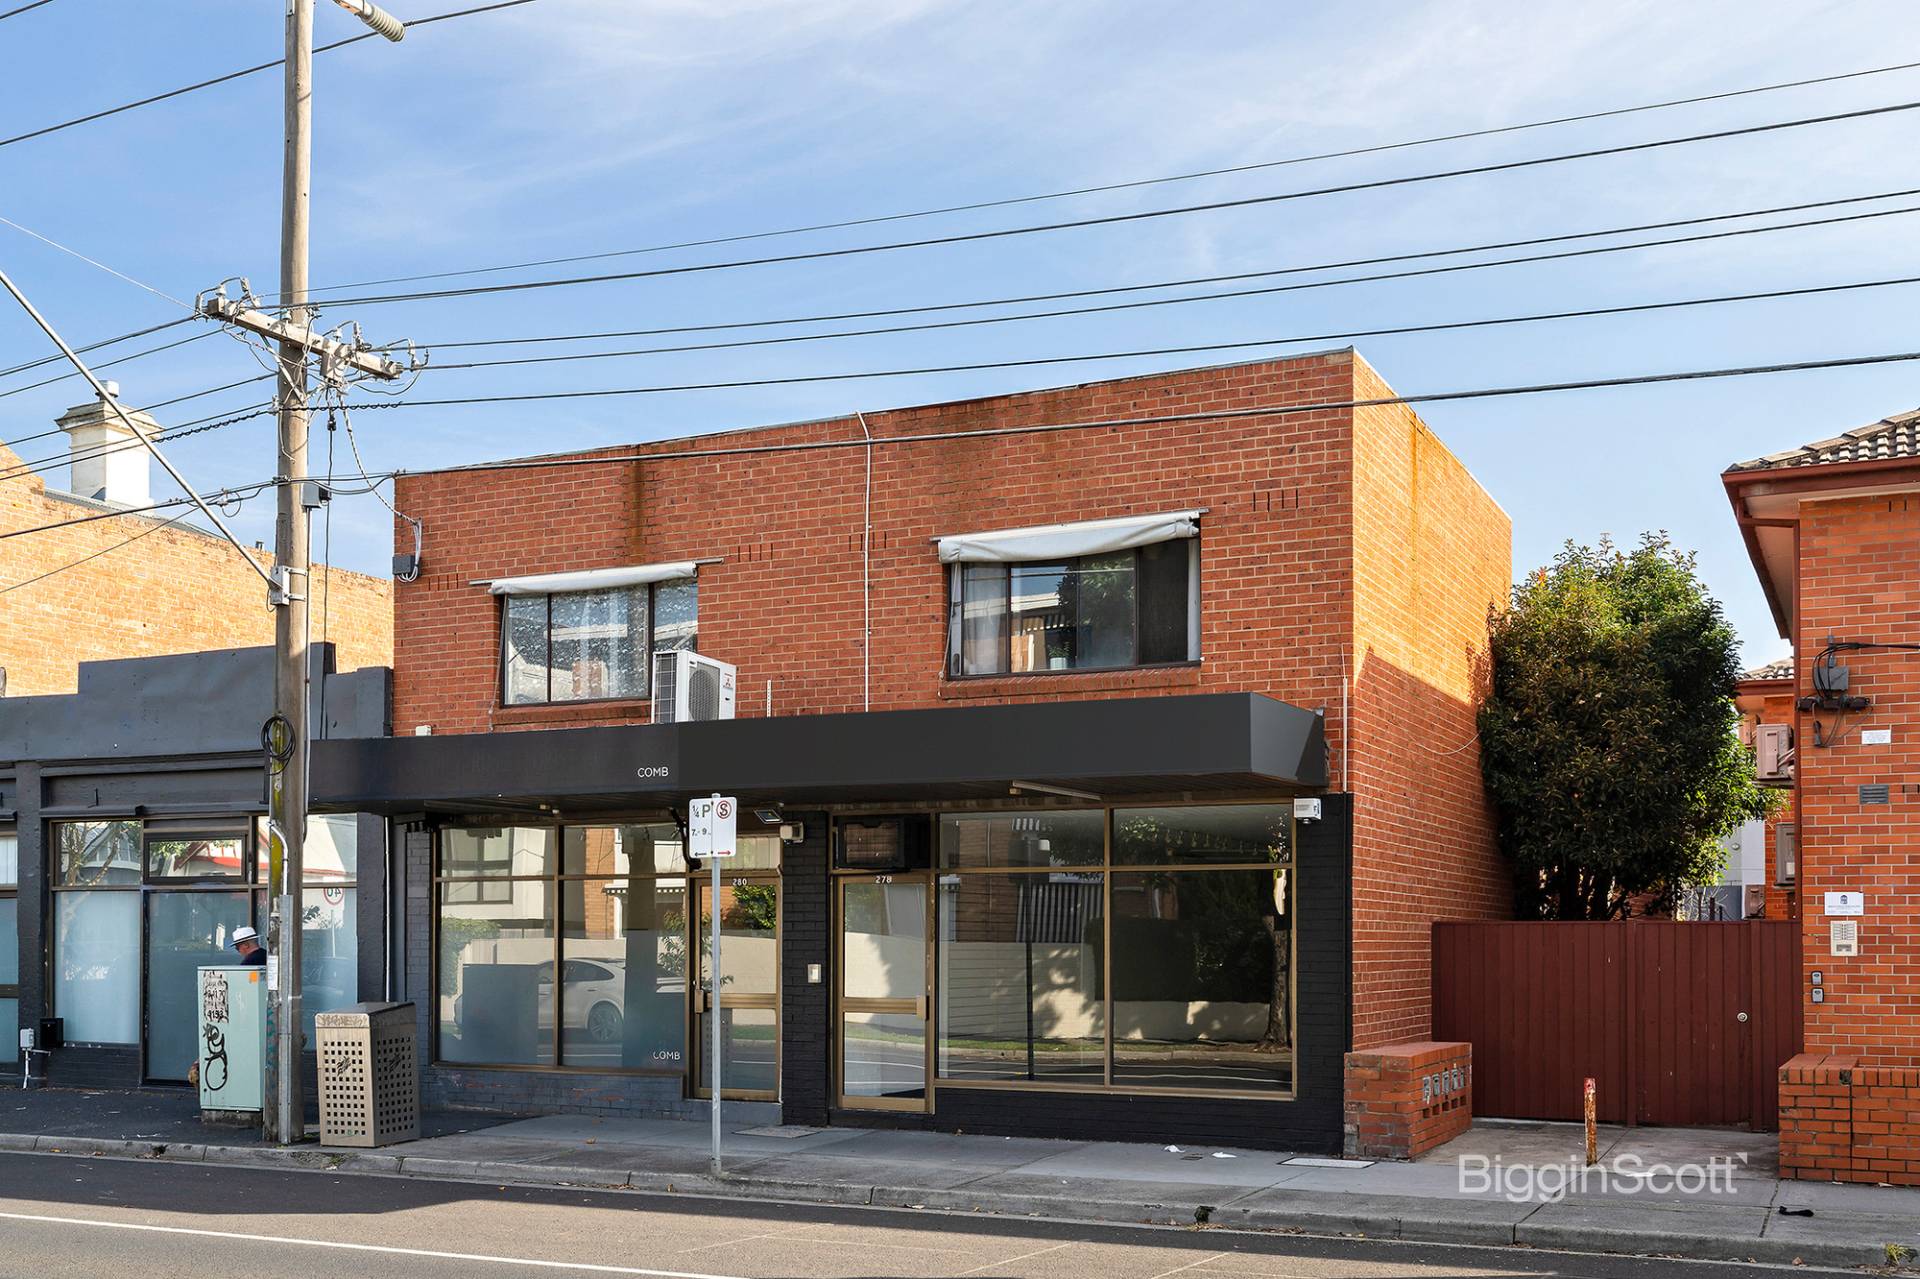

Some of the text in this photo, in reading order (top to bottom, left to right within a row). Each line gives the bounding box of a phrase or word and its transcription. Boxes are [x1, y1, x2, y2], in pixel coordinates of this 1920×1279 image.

[637, 766, 669, 778] COMB
[732, 878, 748, 886] 280
[875, 875, 892, 884] 278
[652, 1051, 681, 1060] COMB
